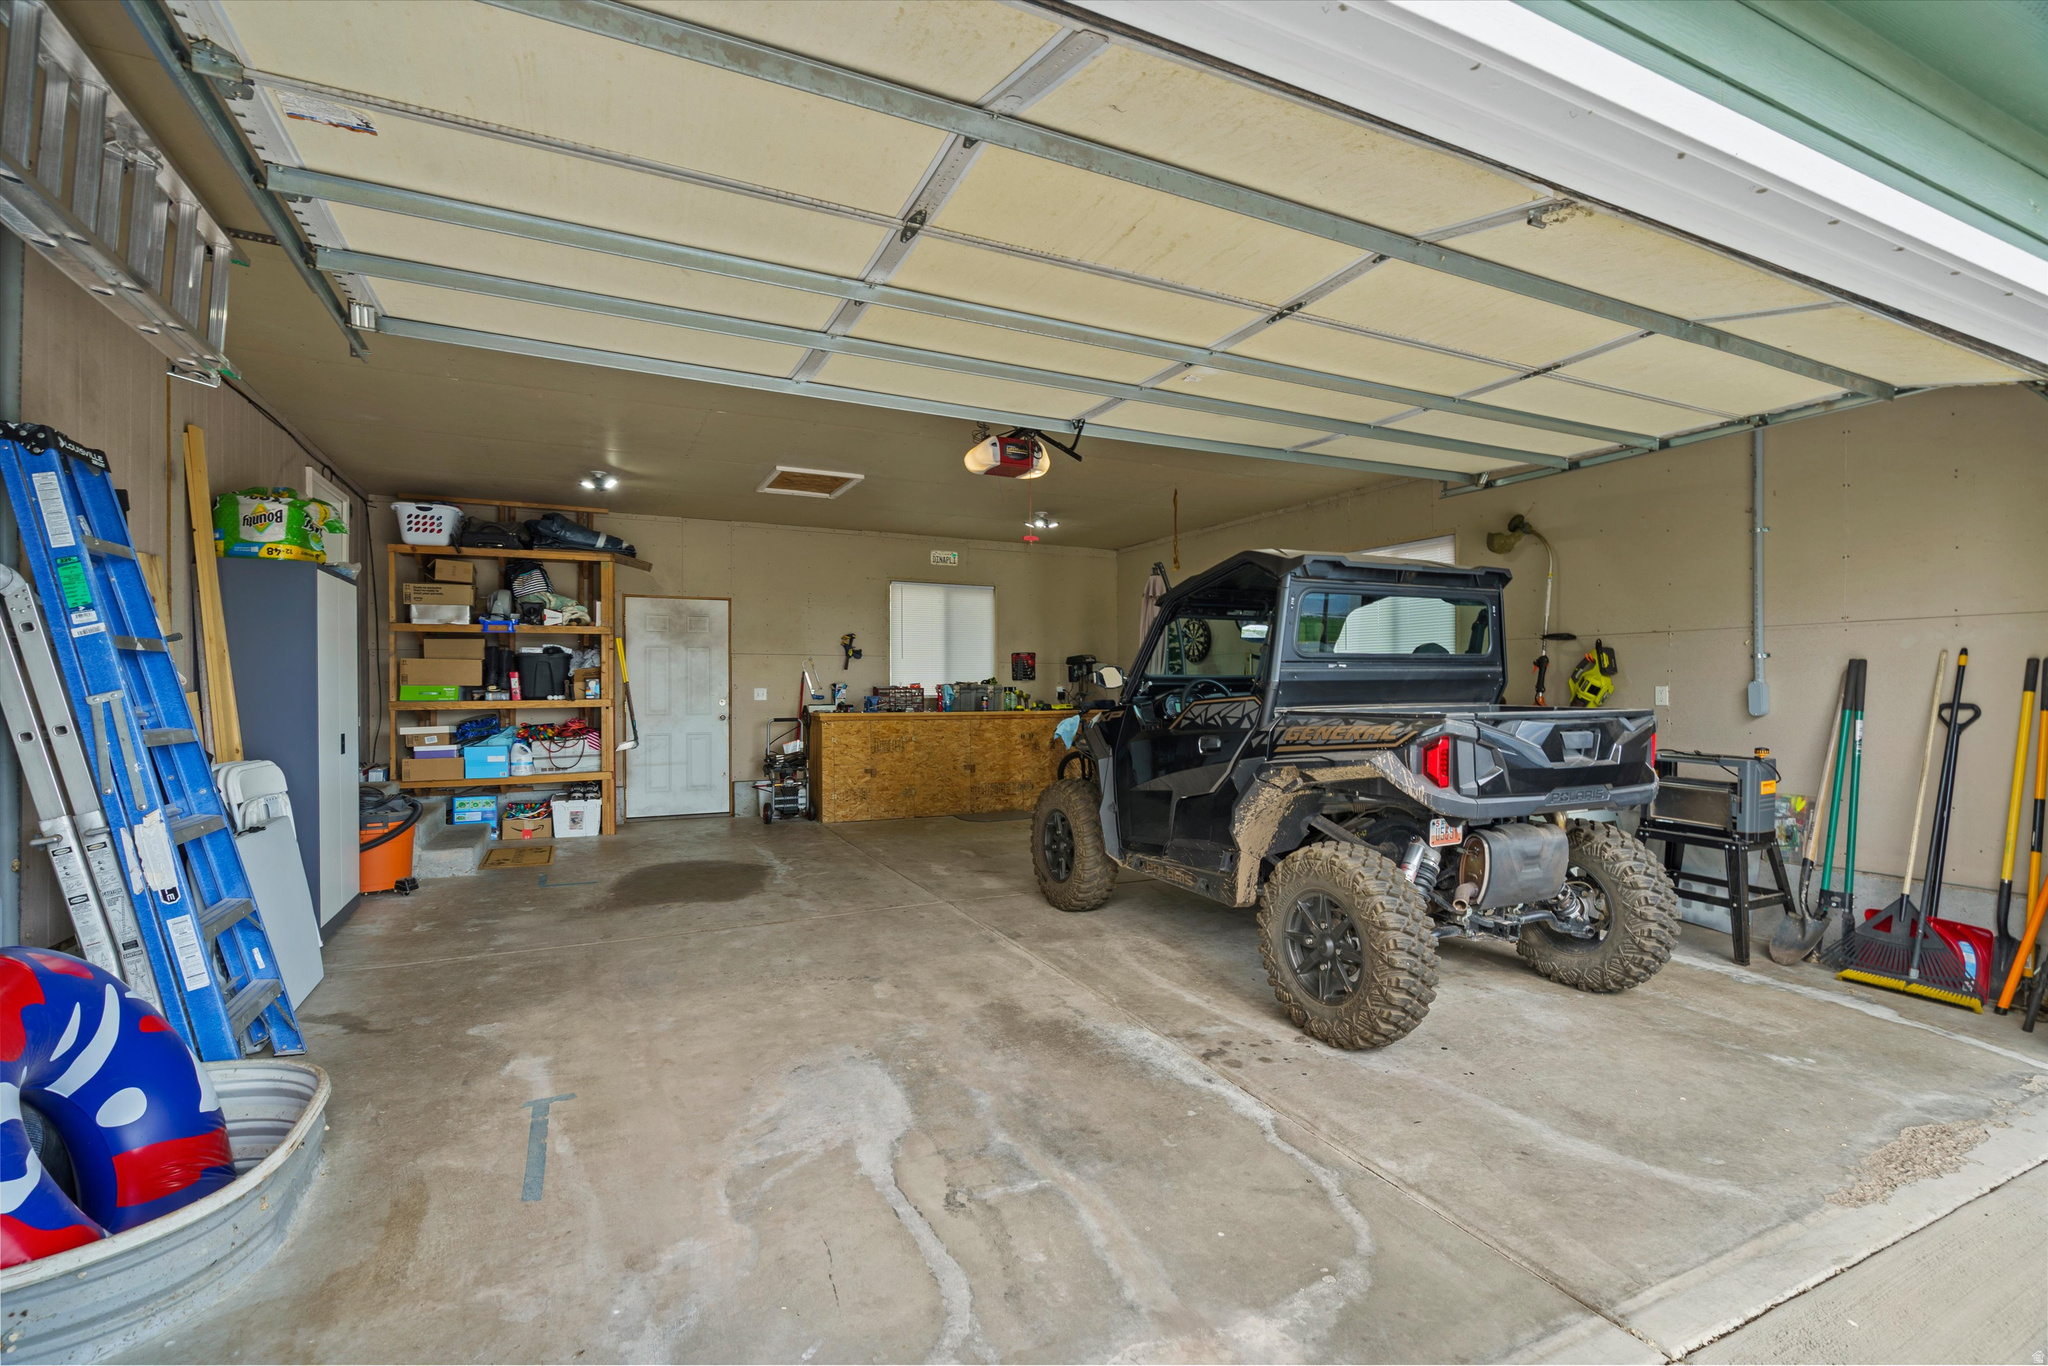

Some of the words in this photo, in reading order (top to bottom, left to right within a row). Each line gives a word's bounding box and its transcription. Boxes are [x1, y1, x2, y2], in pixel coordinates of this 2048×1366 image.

[242, 509, 283, 527] Bounty
[1098, 710, 1124, 722] XP
[1284, 725, 1399, 740] GENERAL
[1551, 789, 1604, 801] POLARIS
